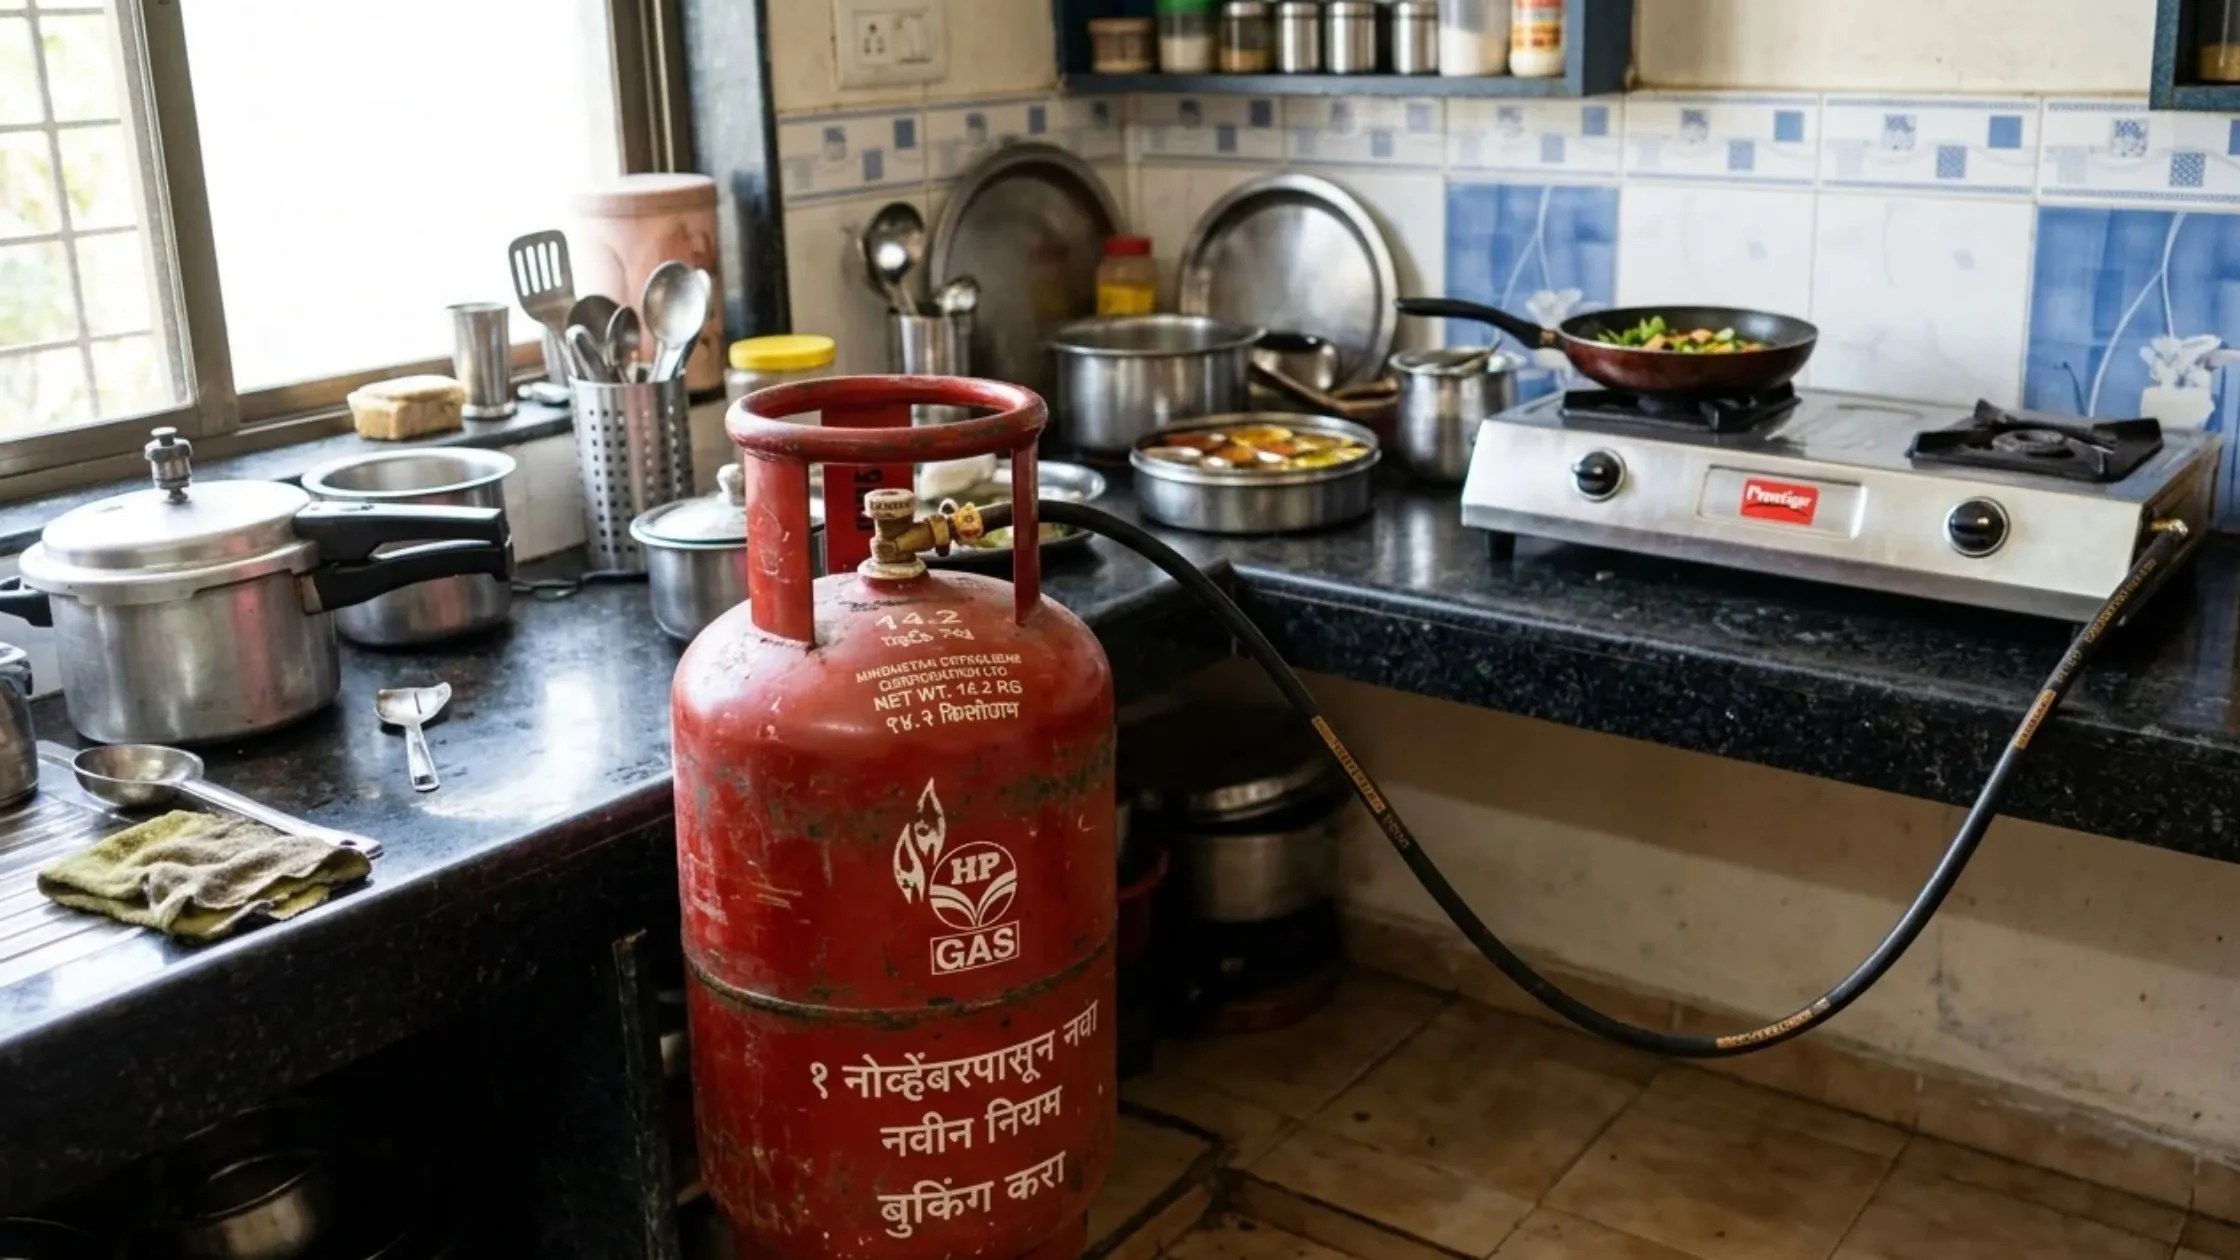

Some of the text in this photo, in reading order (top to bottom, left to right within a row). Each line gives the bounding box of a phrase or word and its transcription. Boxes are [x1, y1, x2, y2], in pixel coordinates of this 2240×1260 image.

[873, 690, 912, 711] NET
[917, 685, 953, 702] WT.
[951, 852, 1000, 885] HP
[936, 927, 1015, 970] GAS
[810, 1061, 828, 1099] १
[841, 1029, 1055, 1101] नोव्हेंबरपासून
[880, 1085, 1062, 1157] नवीन नियम
[877, 1150, 1066, 1239] बुकिंग करा
